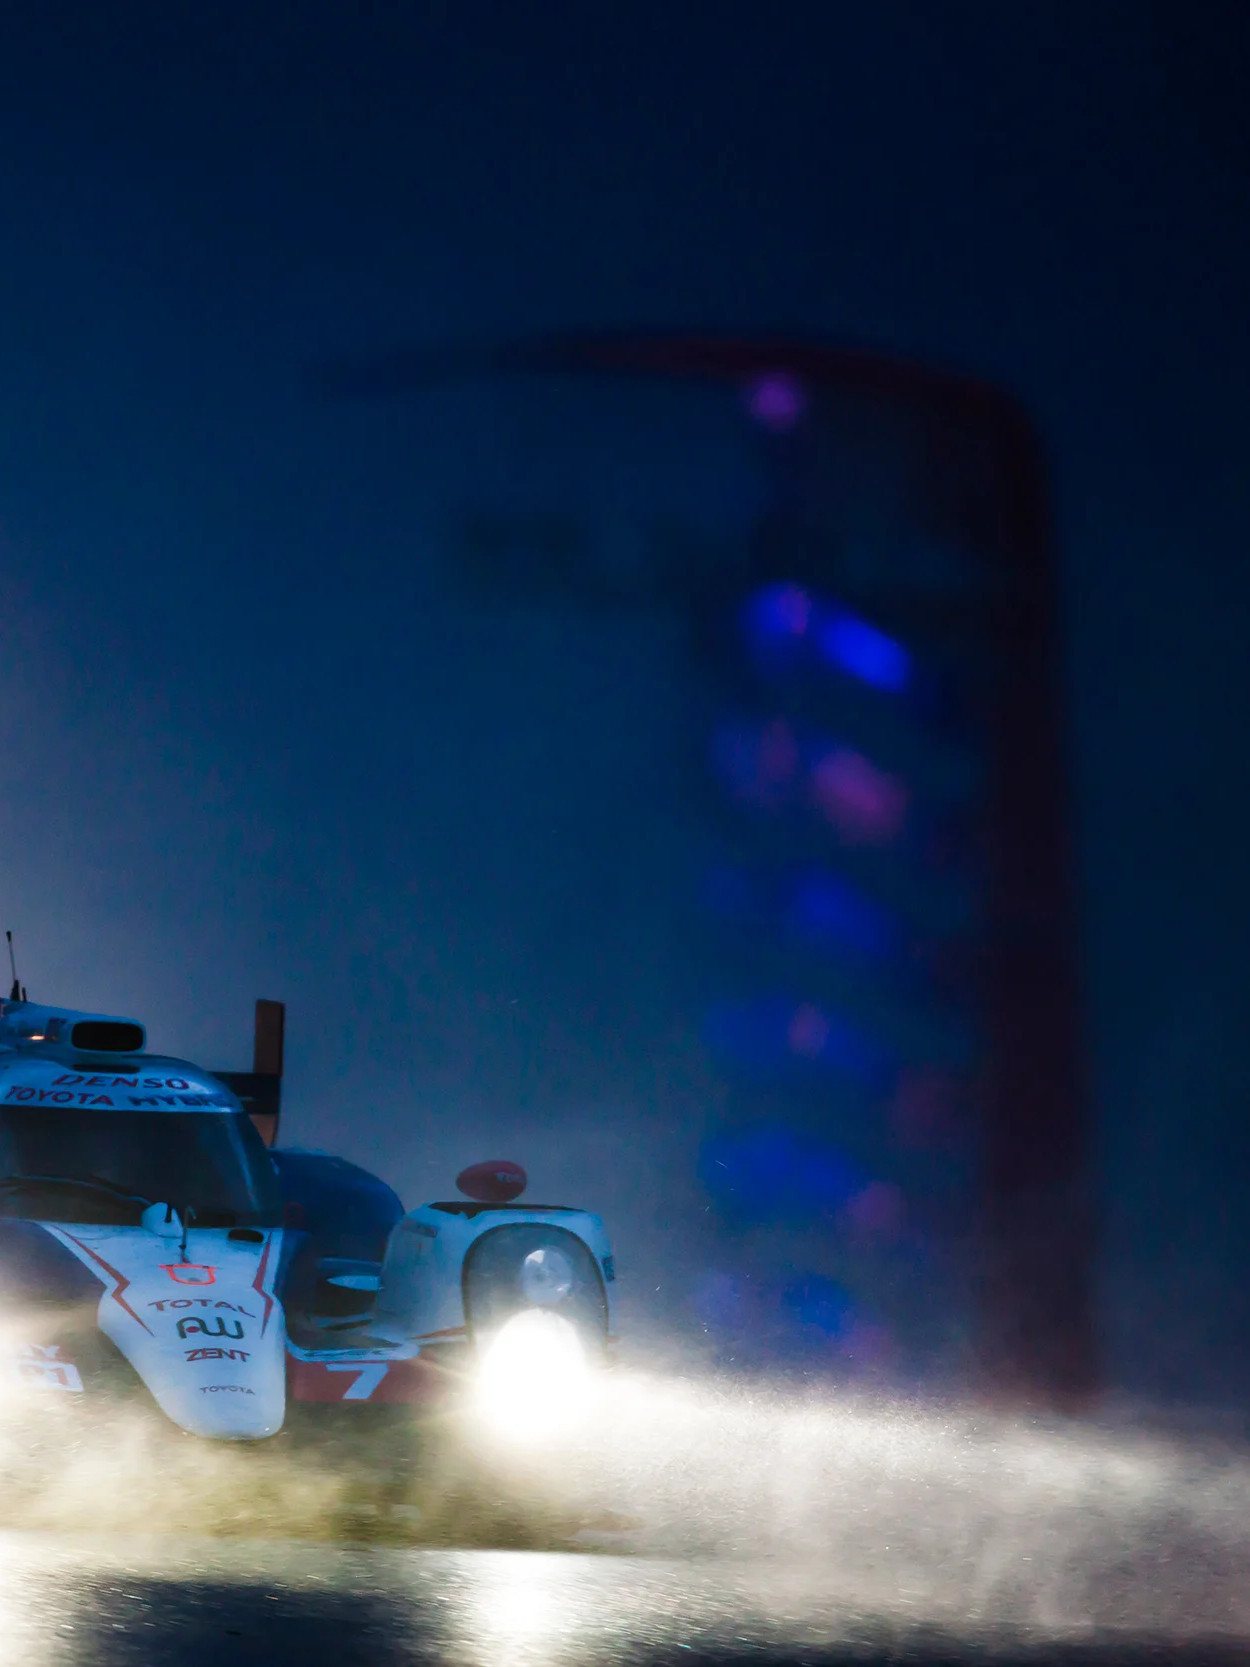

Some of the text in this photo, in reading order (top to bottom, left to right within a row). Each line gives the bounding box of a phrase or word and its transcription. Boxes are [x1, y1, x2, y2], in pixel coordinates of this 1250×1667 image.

[52, 1074, 191, 1090] DENSO
[6, 1086, 115, 1107] TOYOTA
[148, 1299, 256, 1318] TOTAL
[184, 1348, 250, 1362] ZENT
[325, 1362, 389, 1400] 7
[199, 1385, 256, 1395] TOYOTA
